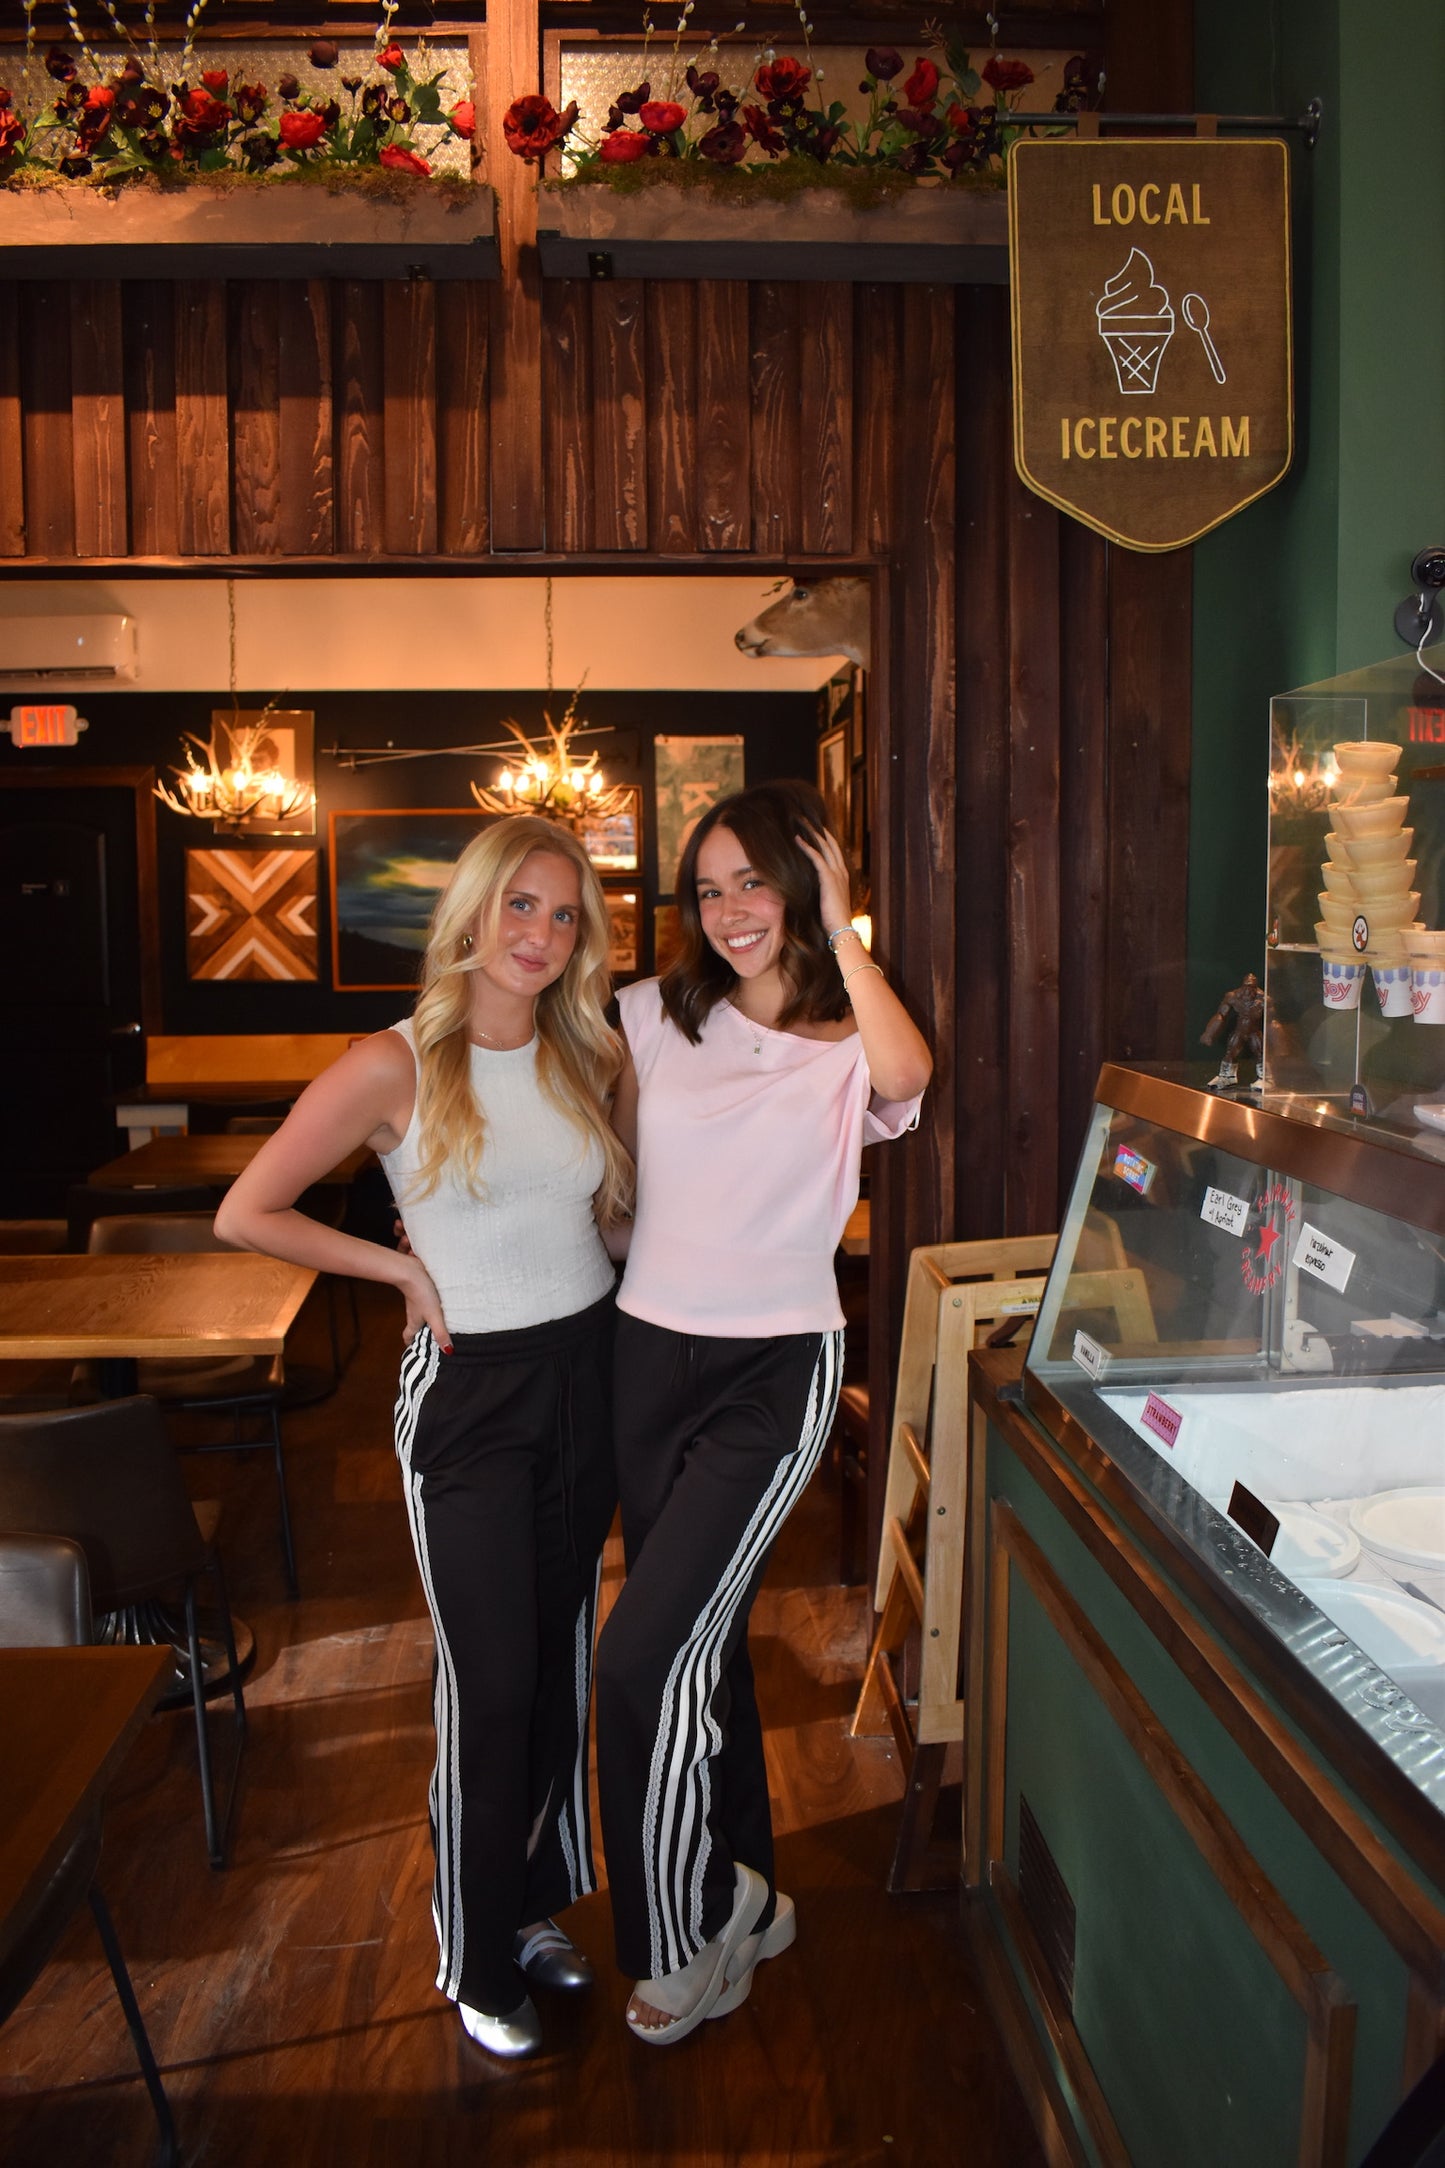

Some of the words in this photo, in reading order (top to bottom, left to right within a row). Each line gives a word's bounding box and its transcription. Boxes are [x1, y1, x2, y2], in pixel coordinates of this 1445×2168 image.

[1093, 183, 1210, 225] LOCAL
[1061, 416, 1250, 459] ICECREAM
[20, 706, 67, 744] EXIT
[1323, 980, 1352, 1002] Joy
[1210, 1190, 1225, 1206] Earl
[1227, 1196, 1243, 1216] Grey
[1215, 1211, 1234, 1228] Apricot
[1258, 1184, 1295, 1222] FAIRWAY
[1241, 1248, 1282, 1296] CREAMERY
[1080, 1345, 1095, 1365] VANILLA
[1146, 1404, 1177, 1438] STRAWBERRY
